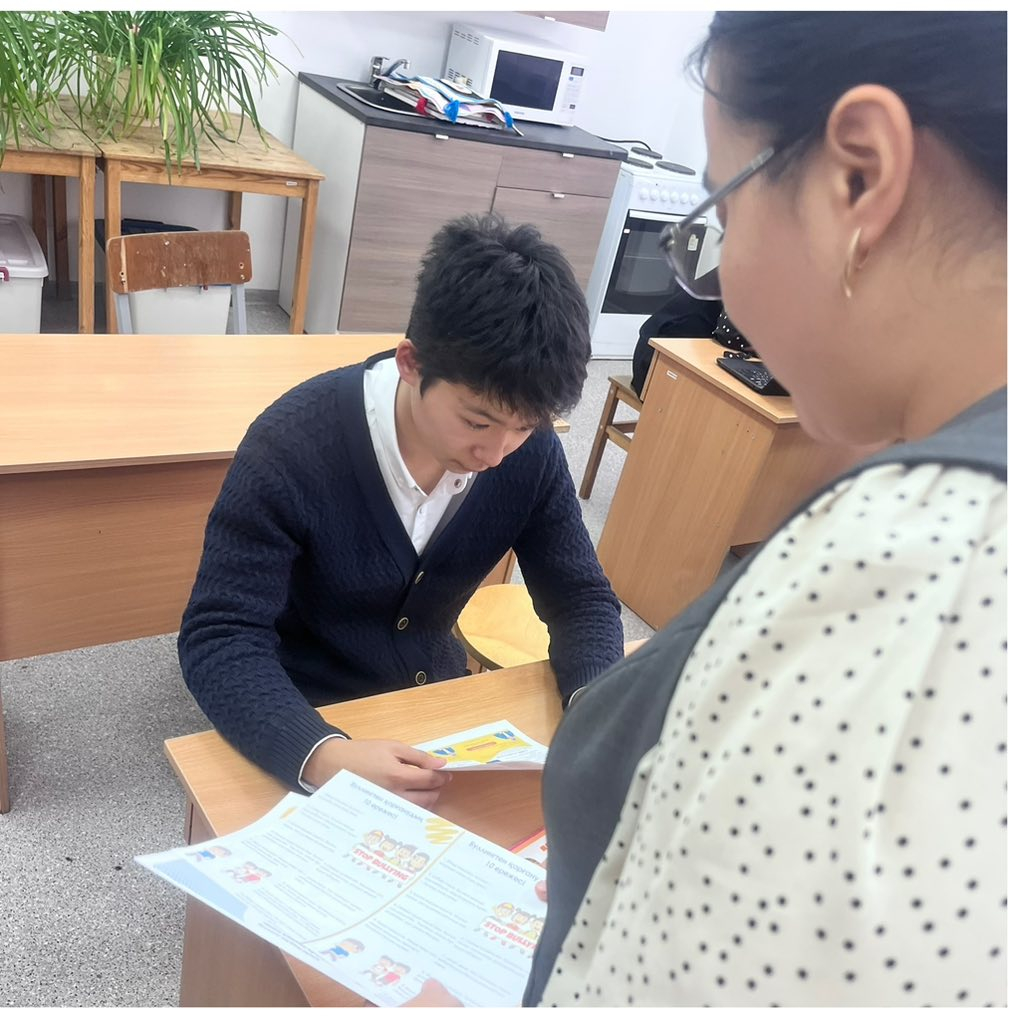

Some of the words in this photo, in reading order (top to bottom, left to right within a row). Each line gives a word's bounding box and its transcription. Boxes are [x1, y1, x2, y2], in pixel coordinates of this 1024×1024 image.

[354, 848, 373, 861] STOP
[484, 921, 507, 935] STOP
[506, 932, 538, 949] BULLY
